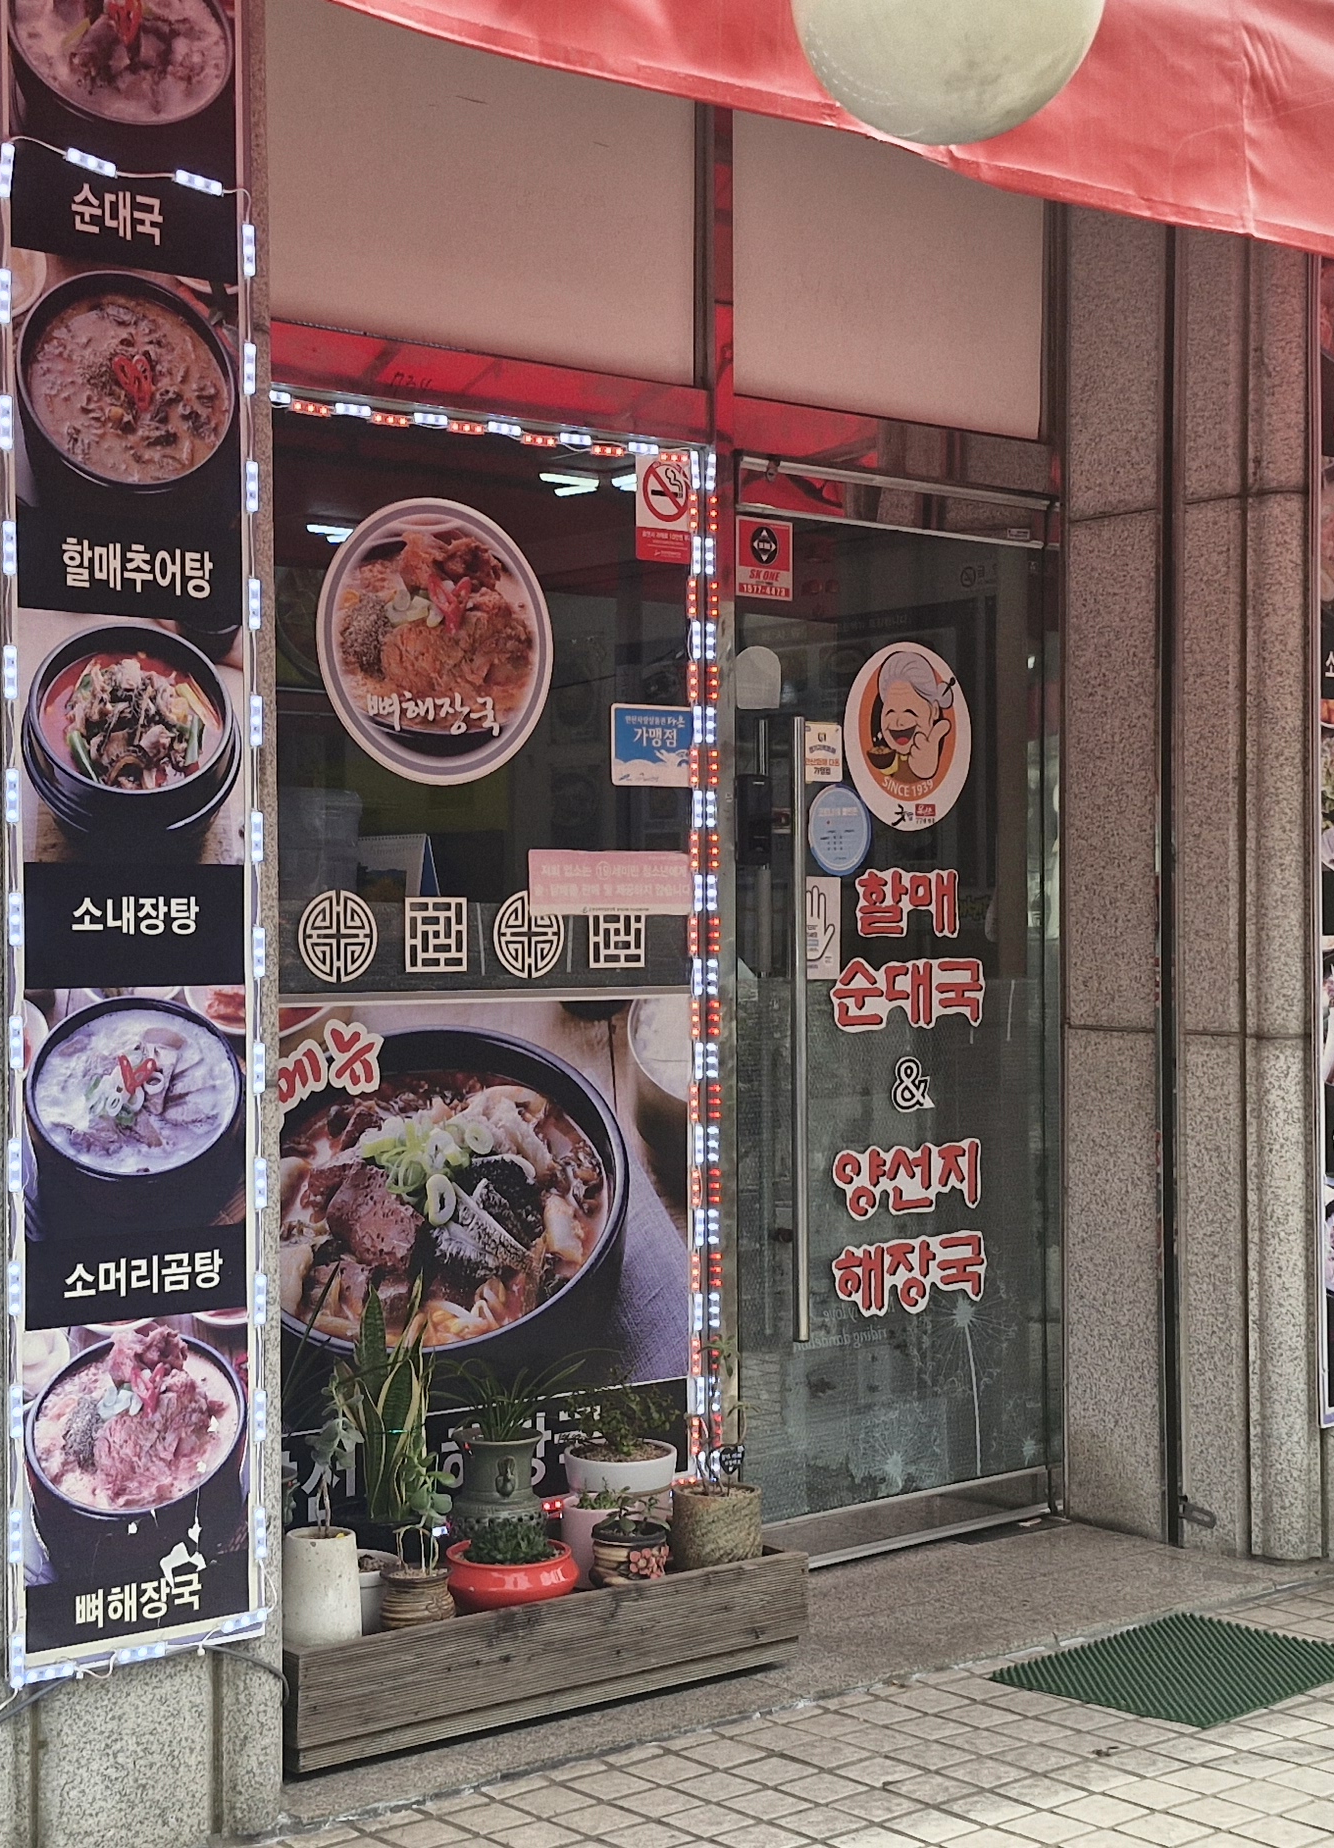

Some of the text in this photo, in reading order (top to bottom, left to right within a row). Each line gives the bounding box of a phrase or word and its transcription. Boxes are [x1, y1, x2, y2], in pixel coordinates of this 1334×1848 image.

[71, 183, 165, 247] 순대국
[61, 537, 214, 600] 할매추어탕
[365, 691, 501, 737] 뼈해장국
[633, 726, 677, 748] 가맹점
[882, 775, 933, 797] SINCE 1939
[541, 864, 560, 878] 저희
[564, 864, 592, 878] 업소는
[642, 865, 687, 878] 청소년에게
[656, 884, 691, 898] 않습니다
[71, 897, 199, 938] 소내장탕
[856, 869, 959, 938] 할매
[832, 958, 984, 1029] 순대국
[892, 1056, 935, 1112] &
[834, 1139, 981, 1219] 양선지
[63, 1248, 224, 1301] 소머리곰탕
[833, 1233, 985, 1315] 해장국
[75, 1577, 202, 1628] 뼈해장국
